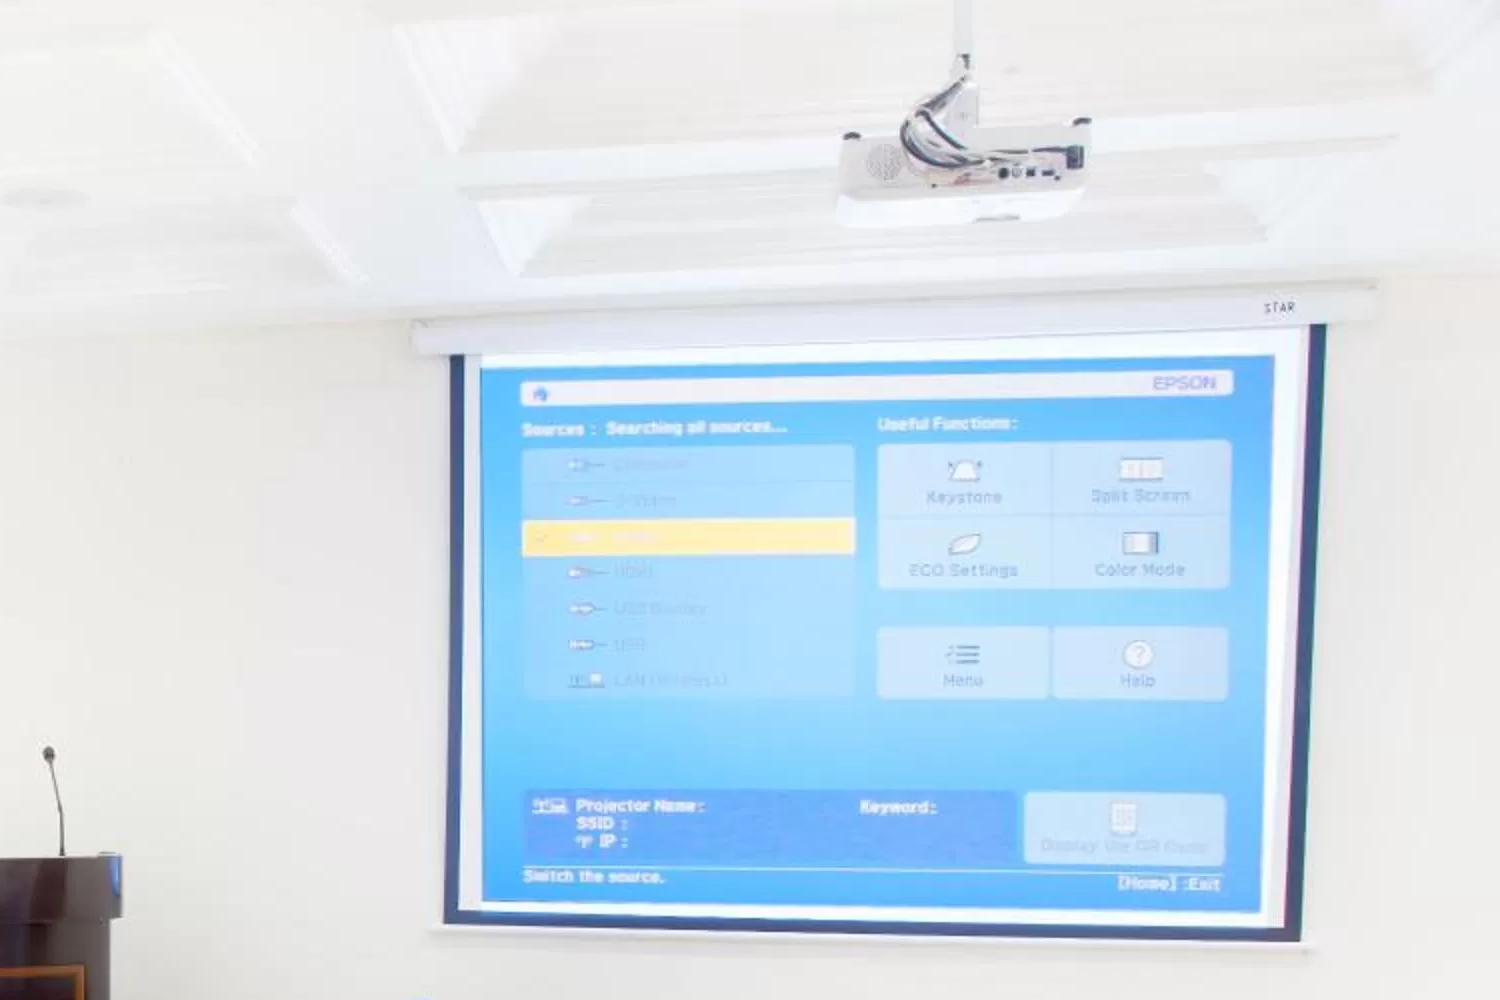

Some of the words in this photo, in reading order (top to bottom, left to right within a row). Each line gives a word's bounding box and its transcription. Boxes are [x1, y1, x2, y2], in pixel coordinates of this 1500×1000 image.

[1264, 301, 1296, 315] STAR
[1153, 375, 1217, 391] EPSON
[522, 423, 585, 437] Sources
[606, 421, 682, 437] Searching
[688, 420, 706, 434] all
[878, 417, 929, 432] Useful
[932, 416, 1018, 432] Functions:
[926, 491, 1002, 504] Keystone
[1091, 489, 1129, 504] Split
[1135, 488, 1191, 503] Screen
[909, 563, 945, 577] ECO
[951, 563, 1019, 579] Settings
[1094, 563, 1137, 577] Color
[1142, 563, 1186, 577] Mode
[943, 674, 984, 687] Menu
[1121, 674, 1156, 688] Help
[576, 799, 650, 814] Projector
[860, 800, 938, 816] Keyword:
[576, 816, 615, 830] SSID
[599, 834, 618, 848] IP
[523, 869, 574, 883] Switch
[580, 870, 604, 883] the
[608, 871, 665, 885] source.
[1118, 874, 1176, 891] [Home]
